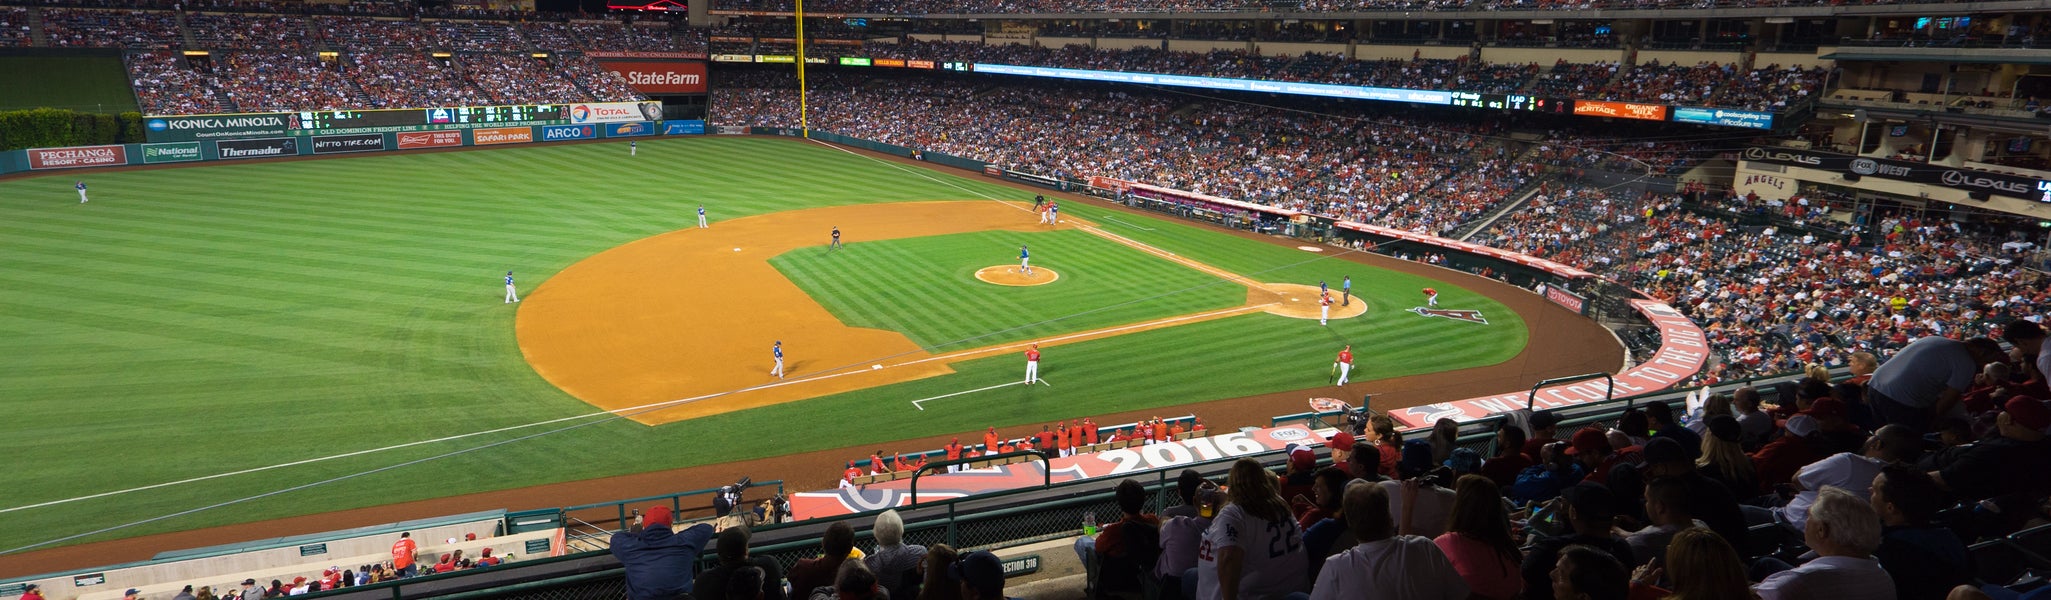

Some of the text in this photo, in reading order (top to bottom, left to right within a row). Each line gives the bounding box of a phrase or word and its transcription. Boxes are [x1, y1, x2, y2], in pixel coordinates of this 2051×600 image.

[594, 108, 629, 116] TOTAL
[1574, 106, 1616, 115] HERITAGE
[1625, 104, 1659, 112] ORGANIC
[169, 117, 283, 129] KONICA MINOLTA
[196, 130, 283, 138] CountOnKonicaMinolta.com
[547, 128, 581, 138] ARCO
[344, 138, 381, 146] TIRE.COM
[40, 148, 115, 160] PECHANGA
[158, 147, 198, 155] National
[222, 146, 282, 157] Thermador
[1766, 151, 1821, 165] LEXUS
[1878, 163, 1912, 177] WEST
[1745, 175, 1784, 190] ANGELS
[1963, 175, 2029, 193] LEXUS
[1557, 293, 1582, 309] TOYOTA
[1667, 328, 1704, 347] BIG
[1654, 346, 1702, 370] THE
[1628, 367, 1680, 385] TO
[1097, 432, 1264, 475] 2016
[1266, 516, 1299, 559] 22
[1026, 557, 1037, 569] 316
